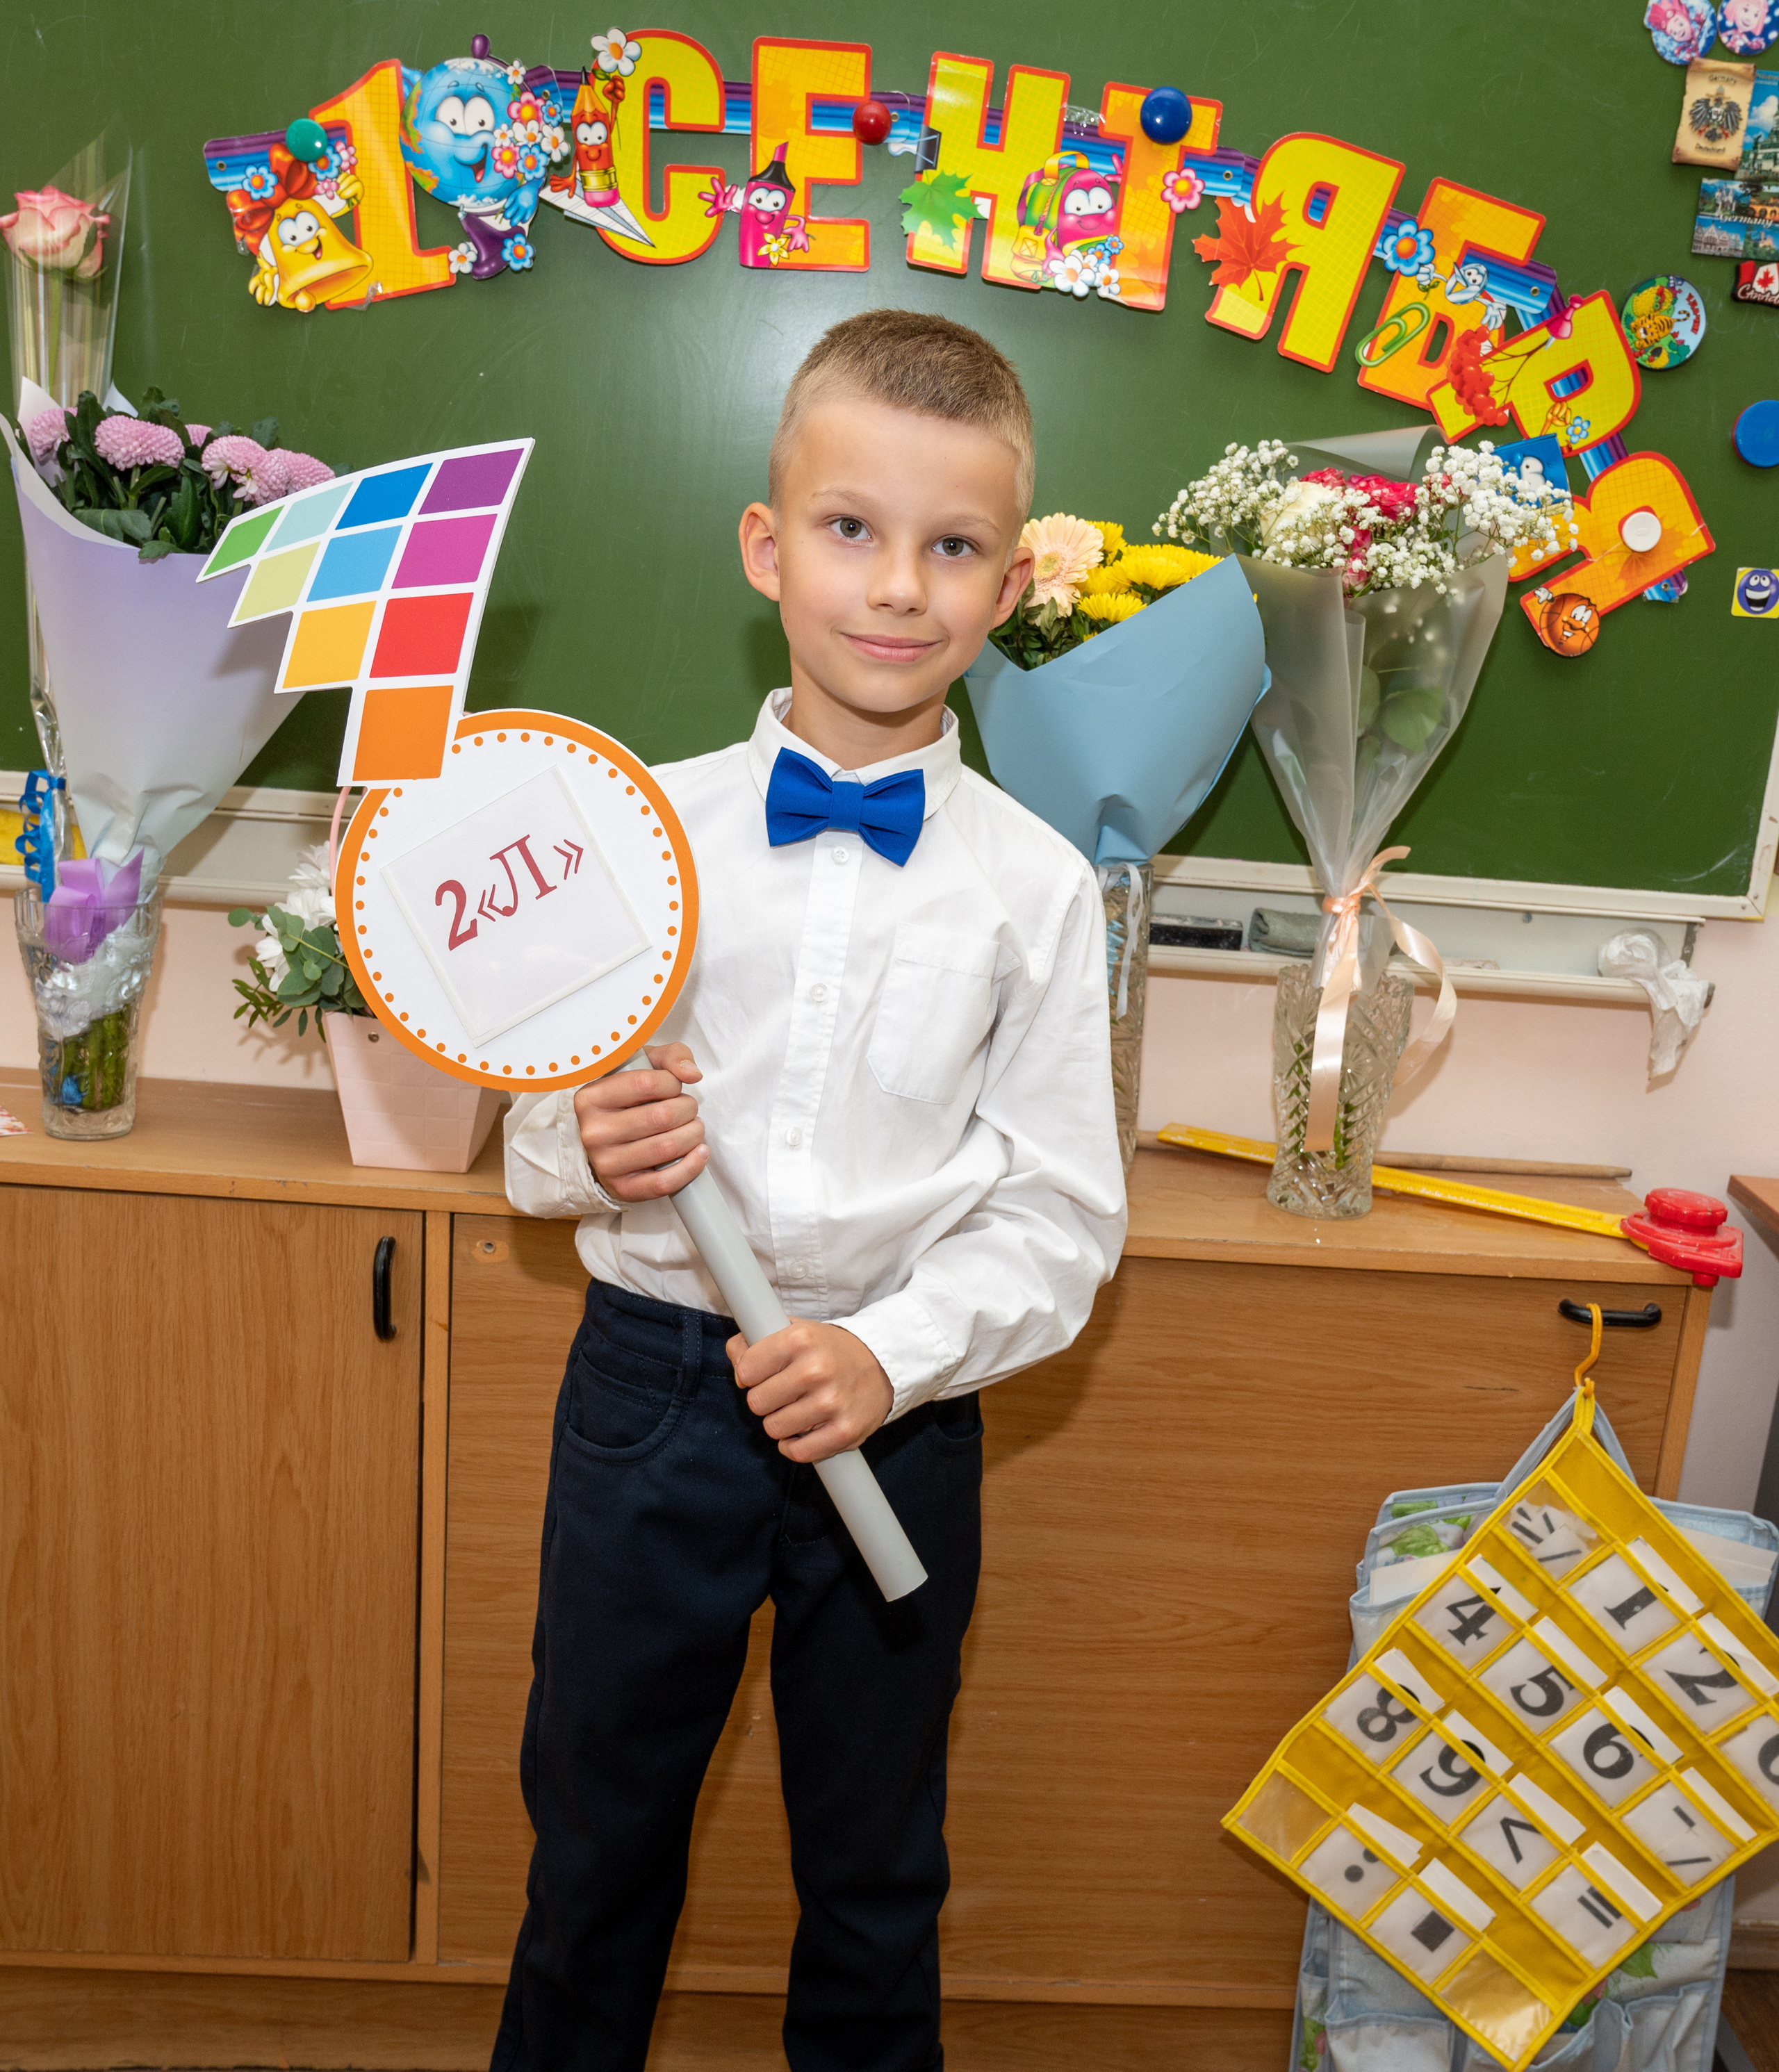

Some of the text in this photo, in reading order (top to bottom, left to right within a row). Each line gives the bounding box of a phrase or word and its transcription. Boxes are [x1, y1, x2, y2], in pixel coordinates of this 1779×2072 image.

[308, 58, 457, 311] 1
[1720, 214, 1774, 229] Germany
[1737, 283, 1779, 306] Canad
[1445, 1586, 1502, 1647] 4
[1510, 1666, 1574, 1717] 5
[1582, 1724, 1655, 1779] 6
[1603, 1583, 1741, 1706] 1 2
[1356, 1684, 1422, 1743] 8
[1419, 1739, 1487, 1797] 9
